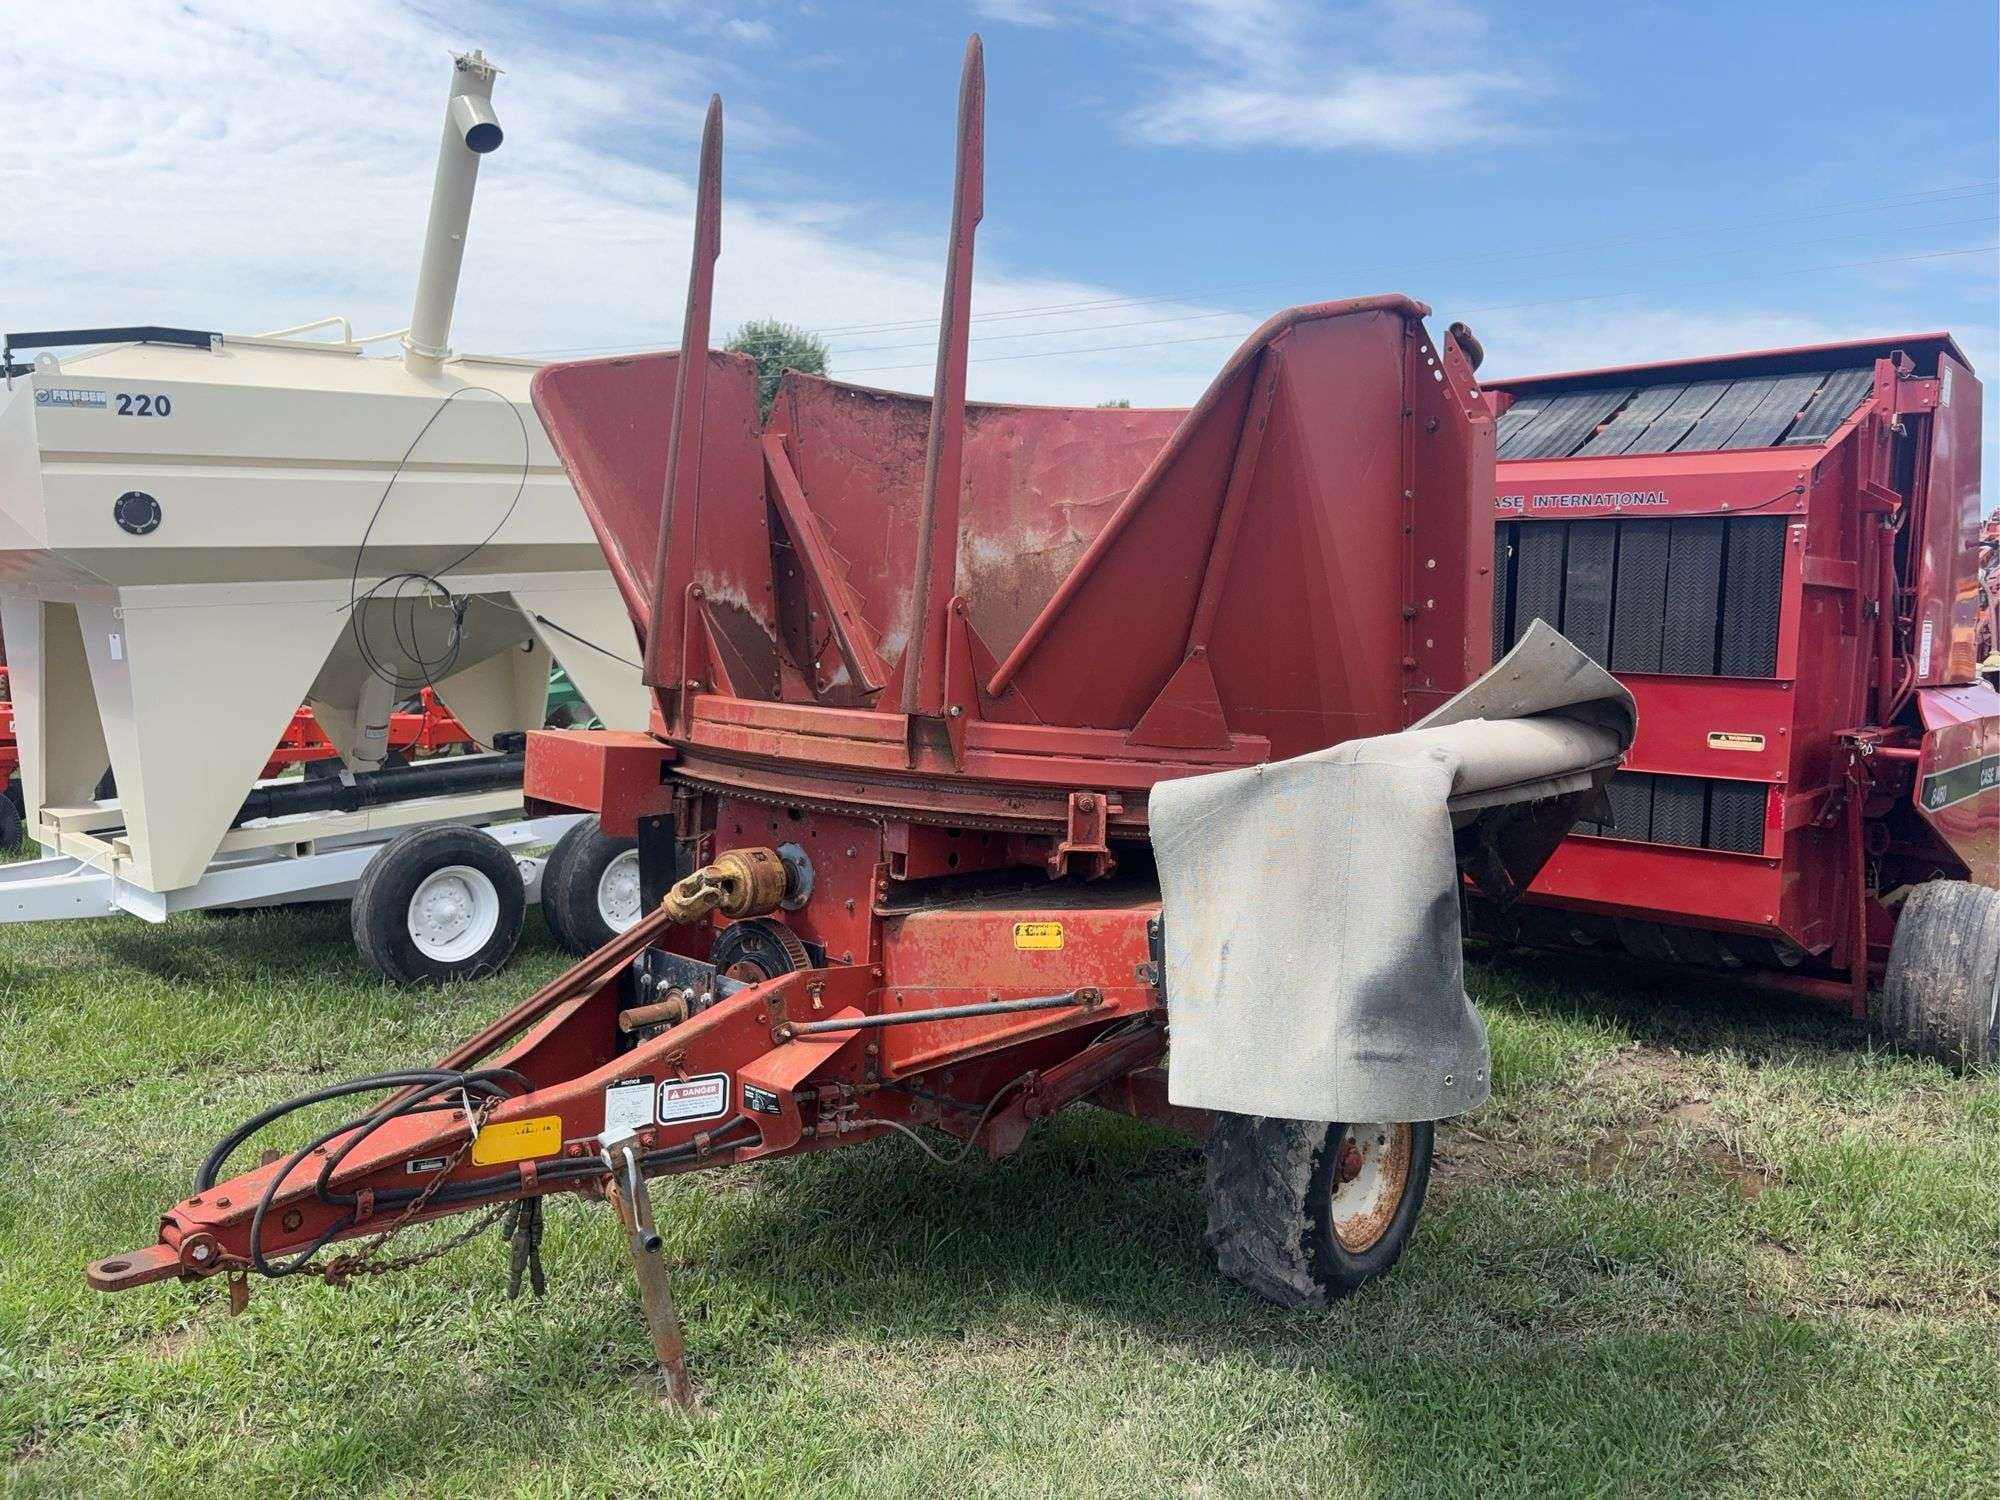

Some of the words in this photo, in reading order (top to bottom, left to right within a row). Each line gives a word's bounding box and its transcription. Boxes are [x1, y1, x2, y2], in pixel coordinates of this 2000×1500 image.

[115, 393, 172, 417] 220
[1494, 496, 1524, 509] ASE
[1533, 492, 1669, 508] INTERNATIONAL
[682, 1085, 717, 1097] DANGER
